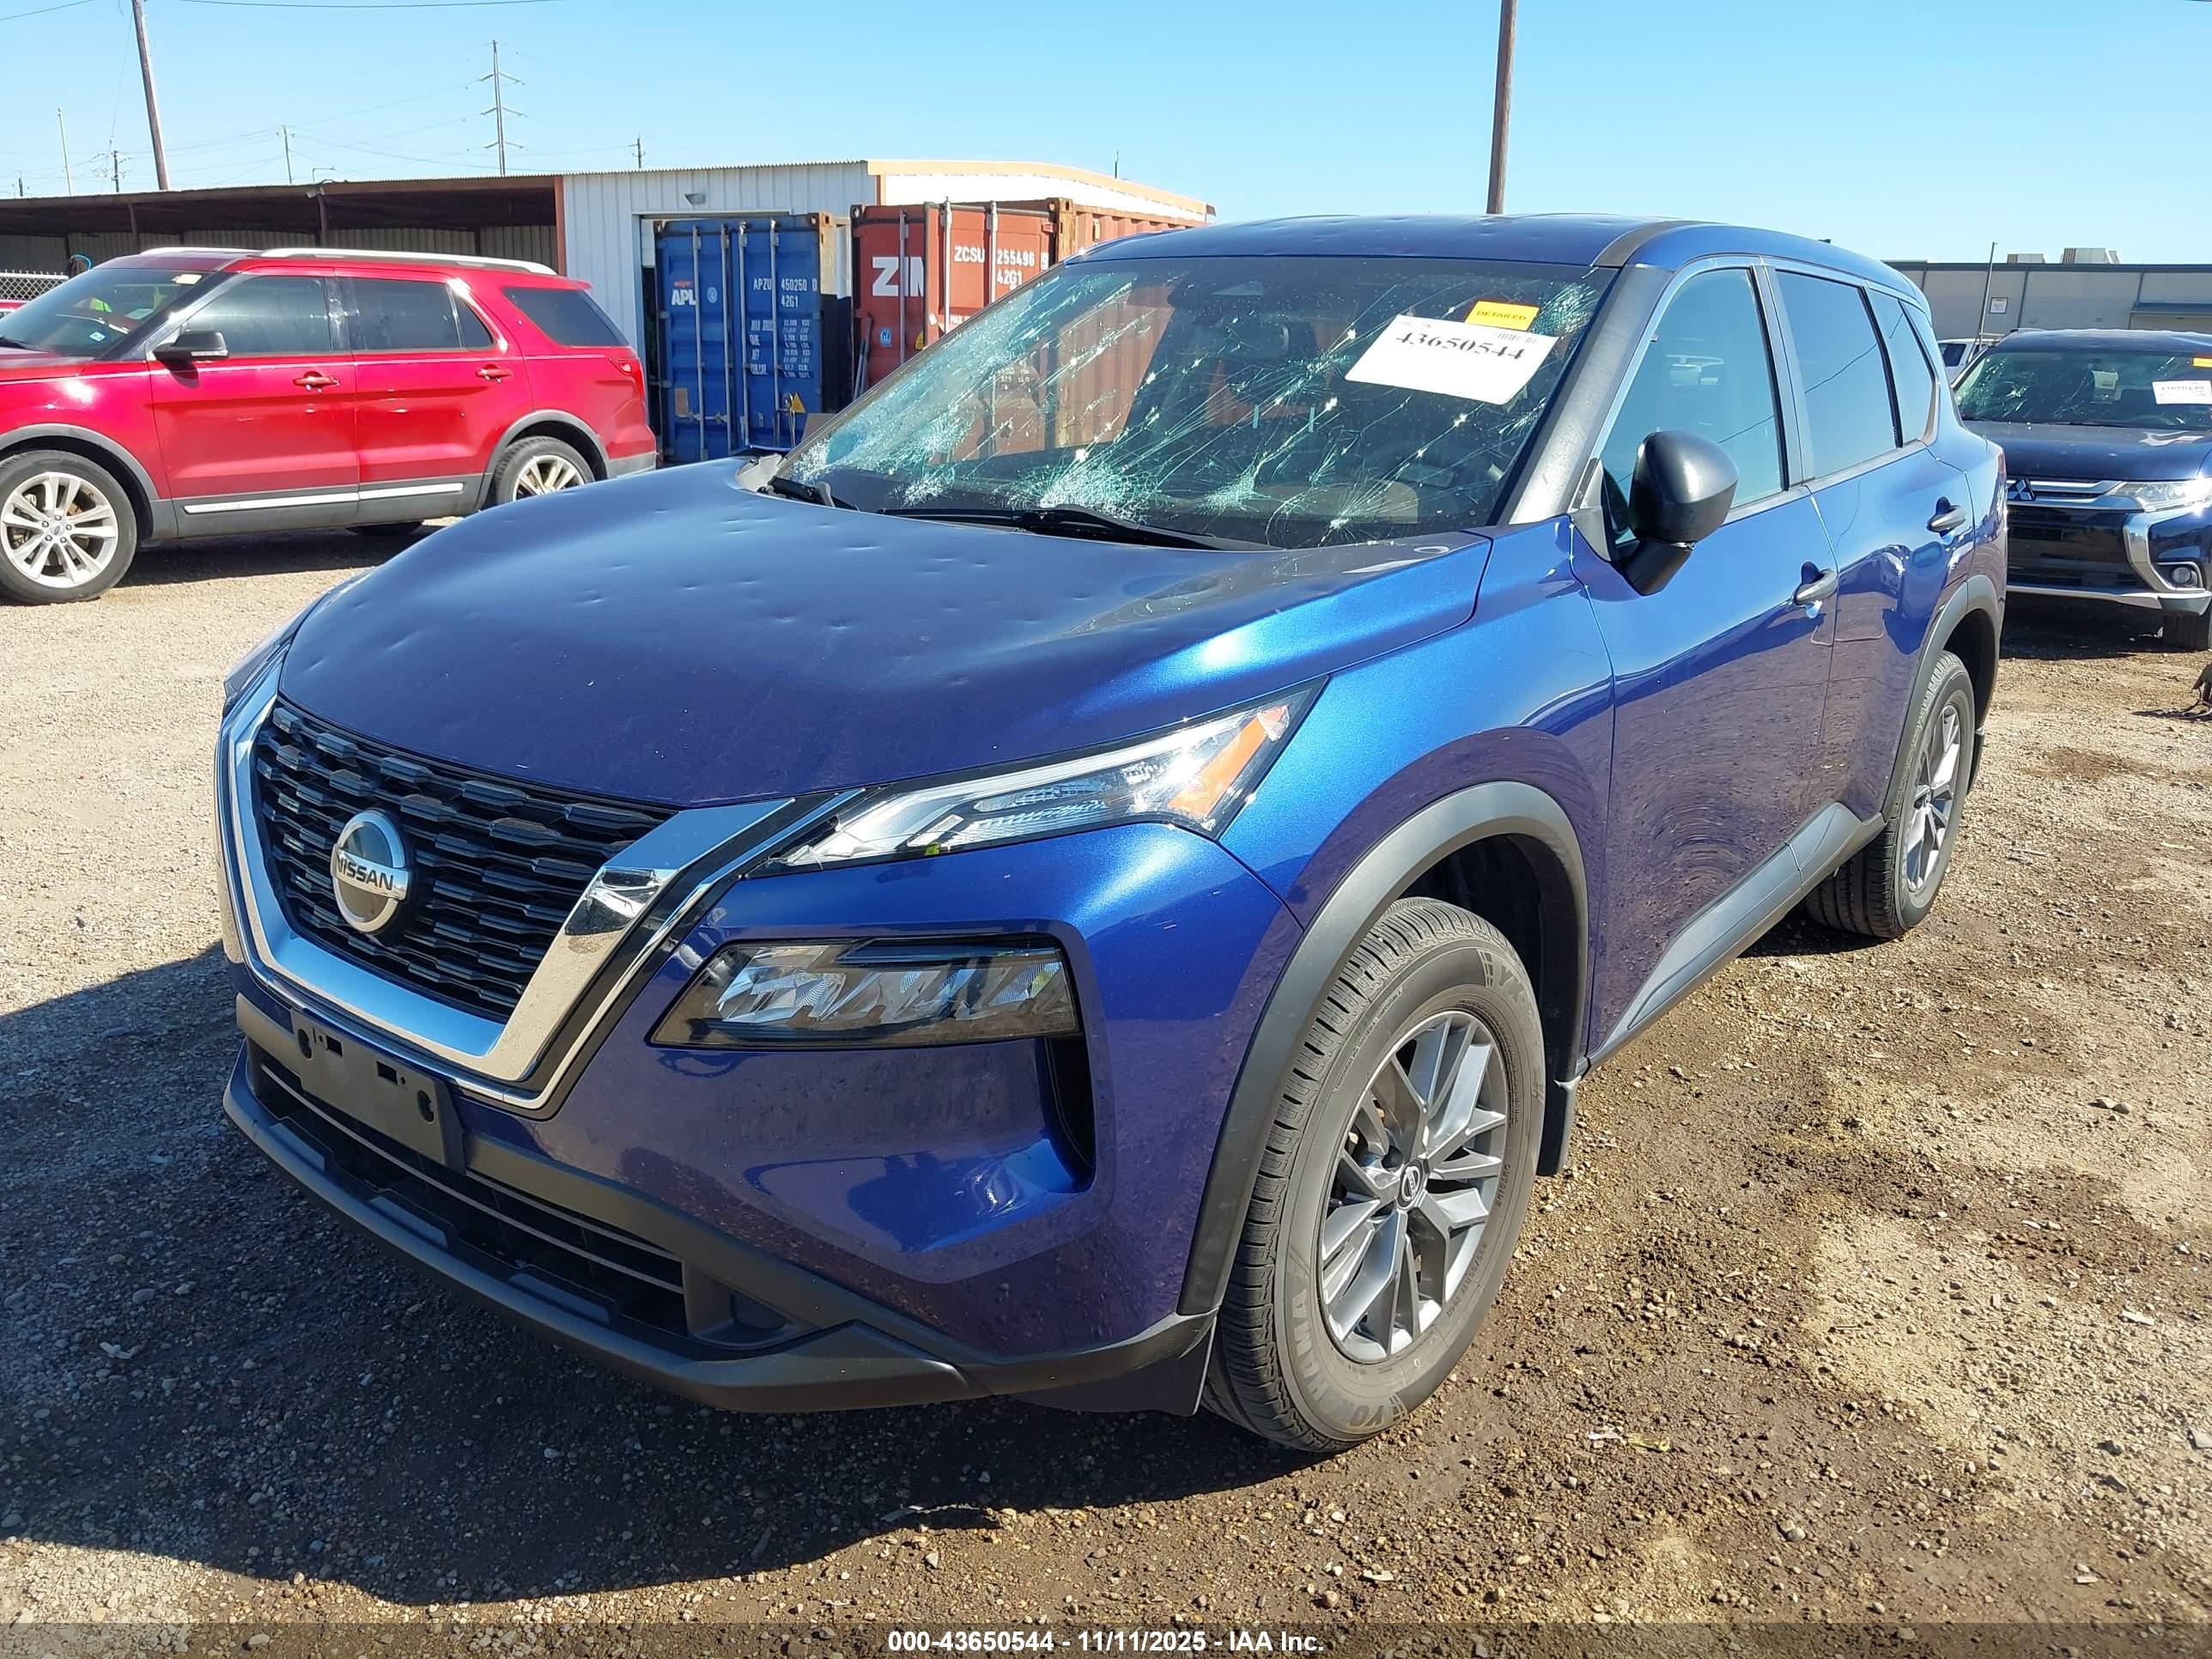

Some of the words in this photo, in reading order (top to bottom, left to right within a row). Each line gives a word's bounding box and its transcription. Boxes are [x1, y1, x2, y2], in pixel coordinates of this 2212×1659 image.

[954, 246, 985, 264] ZCSU
[996, 249, 1036, 267] 255496
[753, 277, 772, 291] APZU
[781, 277, 807, 292] 450250
[997, 269, 1023, 286] 42G1
[671, 289, 696, 306] APL
[781, 295, 799, 308] 42G1
[1476, 310, 1527, 321] DETAILED
[1396, 331, 1525, 360] 43650544
[337, 854, 394, 891] NISSAN
